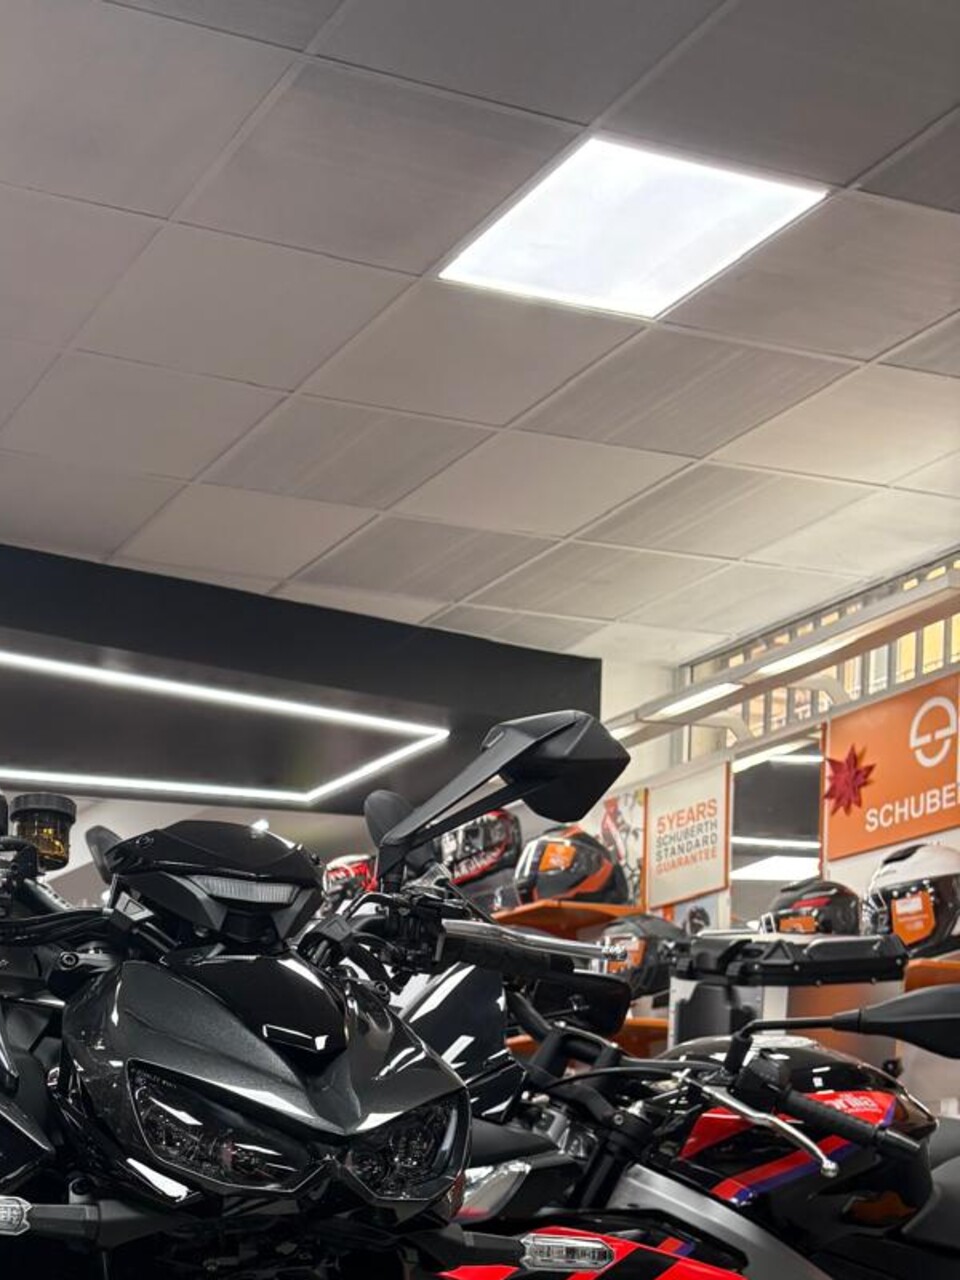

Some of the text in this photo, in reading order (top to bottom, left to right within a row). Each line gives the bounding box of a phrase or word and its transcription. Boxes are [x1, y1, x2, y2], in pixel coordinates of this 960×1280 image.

[864, 783, 960, 833] SCHUBE
[655, 818, 718, 849] SCHUBERTH
[655, 832, 718, 862] STANDARD
[655, 846, 718, 876] GUARANTEE
